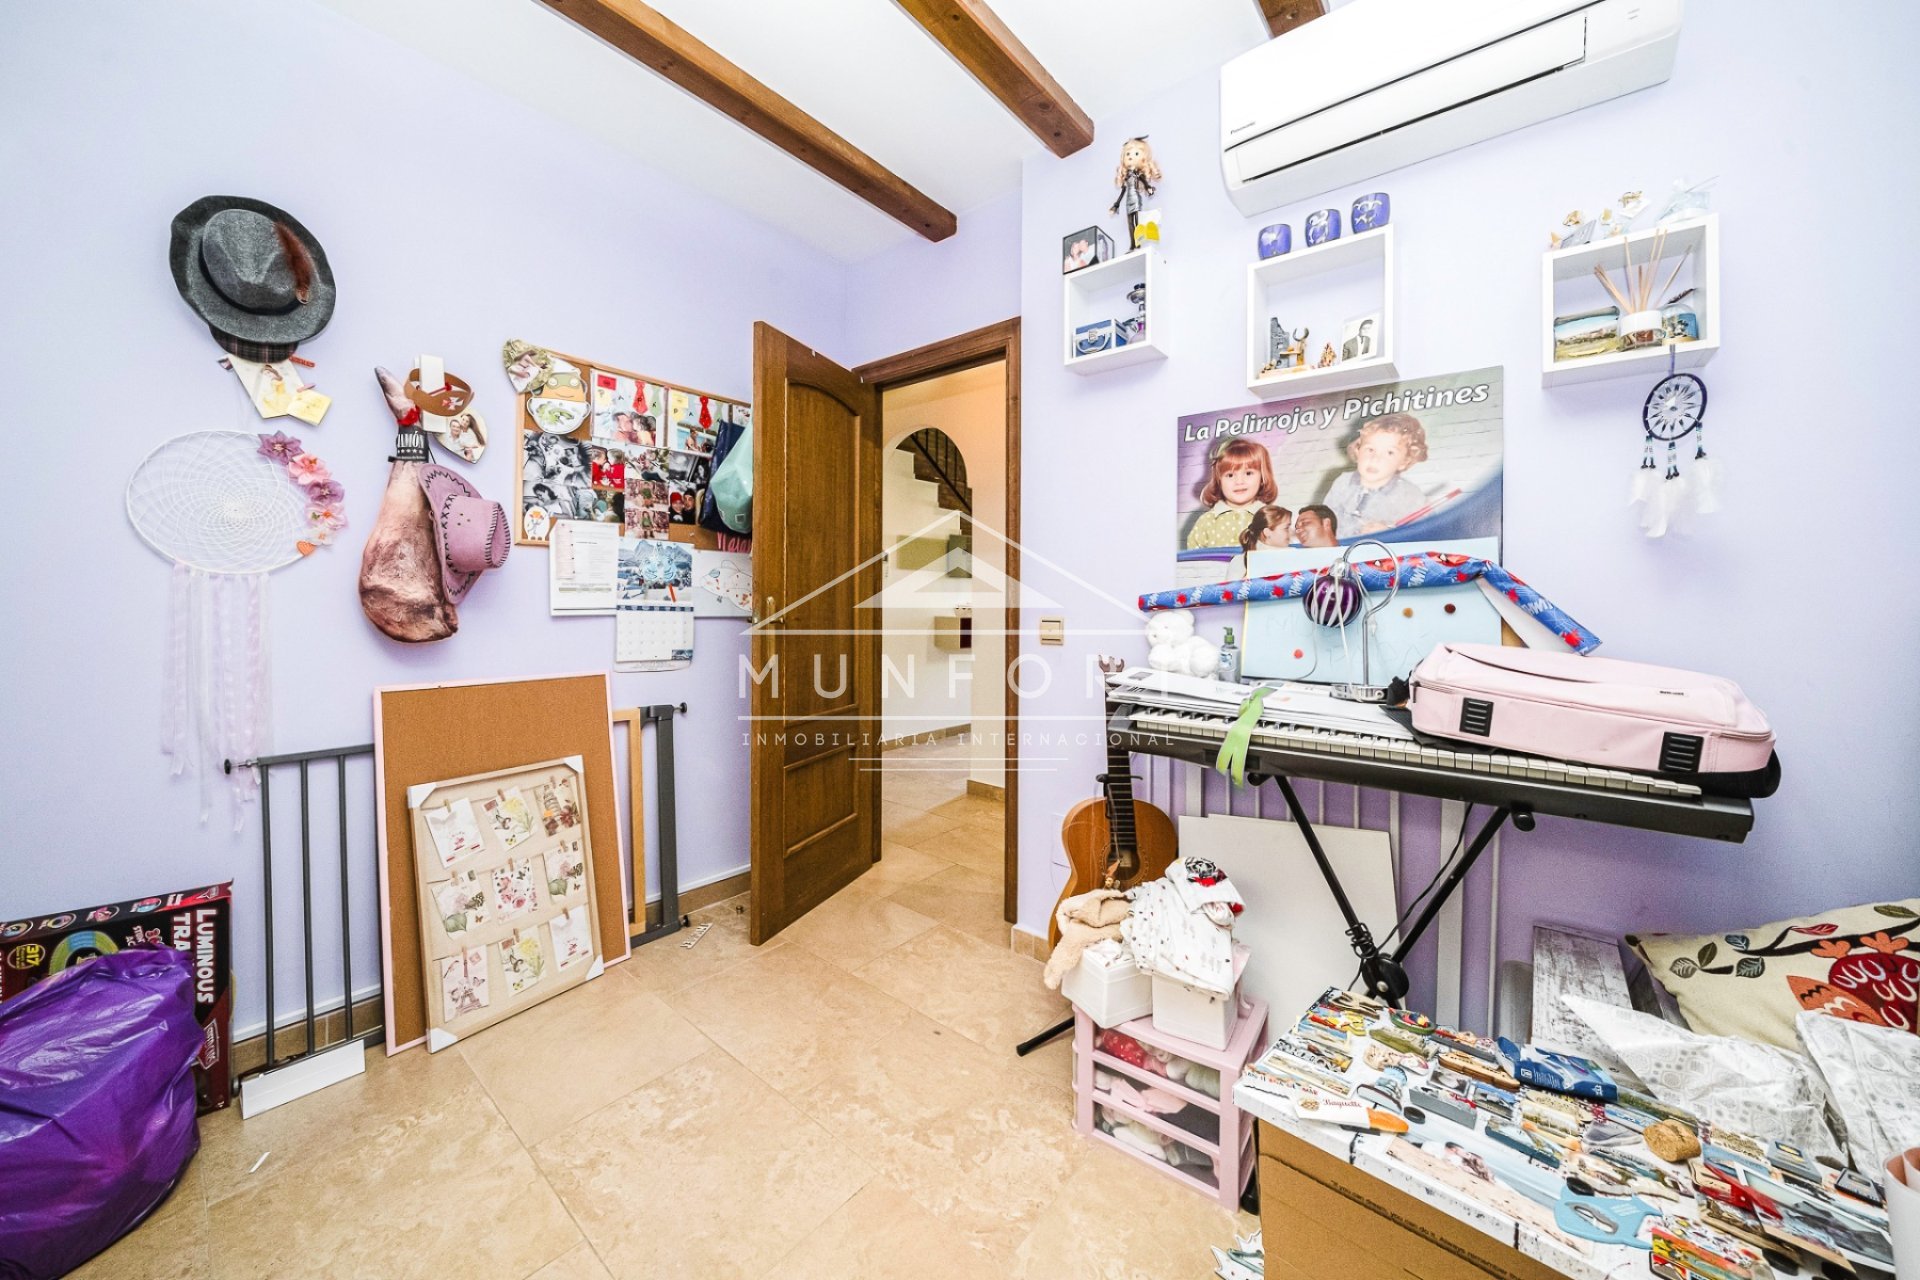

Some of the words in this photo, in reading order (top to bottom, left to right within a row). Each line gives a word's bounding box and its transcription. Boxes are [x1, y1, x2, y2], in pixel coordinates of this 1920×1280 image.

[1184, 424, 1210, 442] La
[1215, 406, 1316, 439] Pelirroja
[1319, 406, 1337, 430] y
[1343, 384, 1490, 421] Pichitines
[26, 944, 40, 966] 317
[173, 912, 191, 951] TRA
[196, 909, 217, 1004] LUMINOUS
